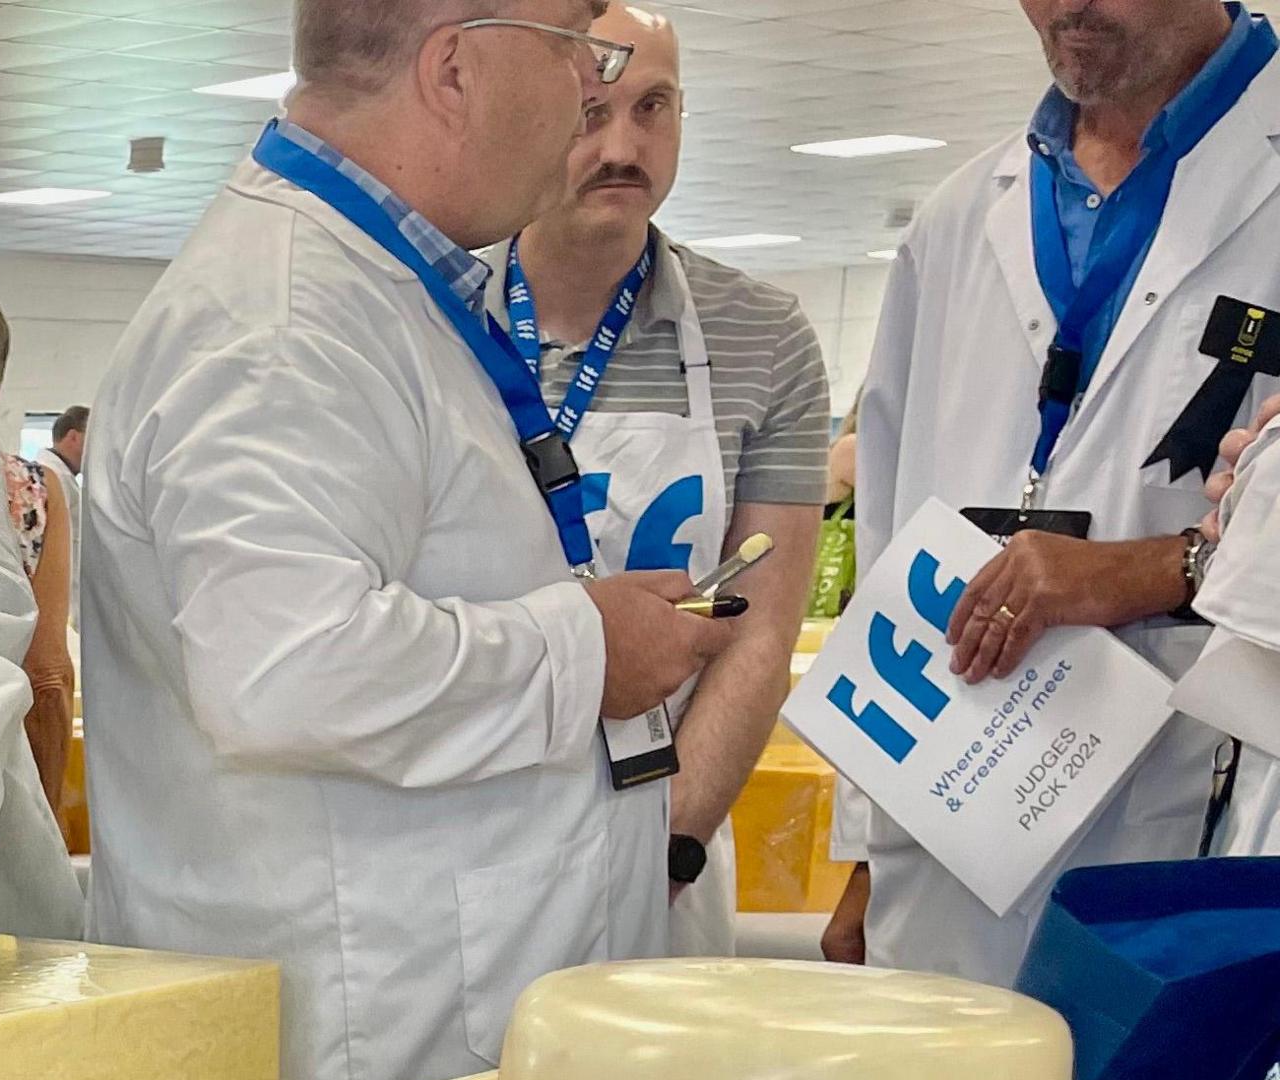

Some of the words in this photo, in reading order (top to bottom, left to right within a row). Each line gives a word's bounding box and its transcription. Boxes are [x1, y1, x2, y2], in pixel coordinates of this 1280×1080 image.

[929, 740, 984, 798] Where
[983, 668, 1039, 739] science
[945, 797, 965, 812] &
[963, 711, 1033, 796] creativity
[1031, 659, 1072, 711] meet
[1013, 727, 1077, 805] JUDGES
[1018, 778, 1068, 832] PACK
[1062, 732, 1102, 780] 2024
